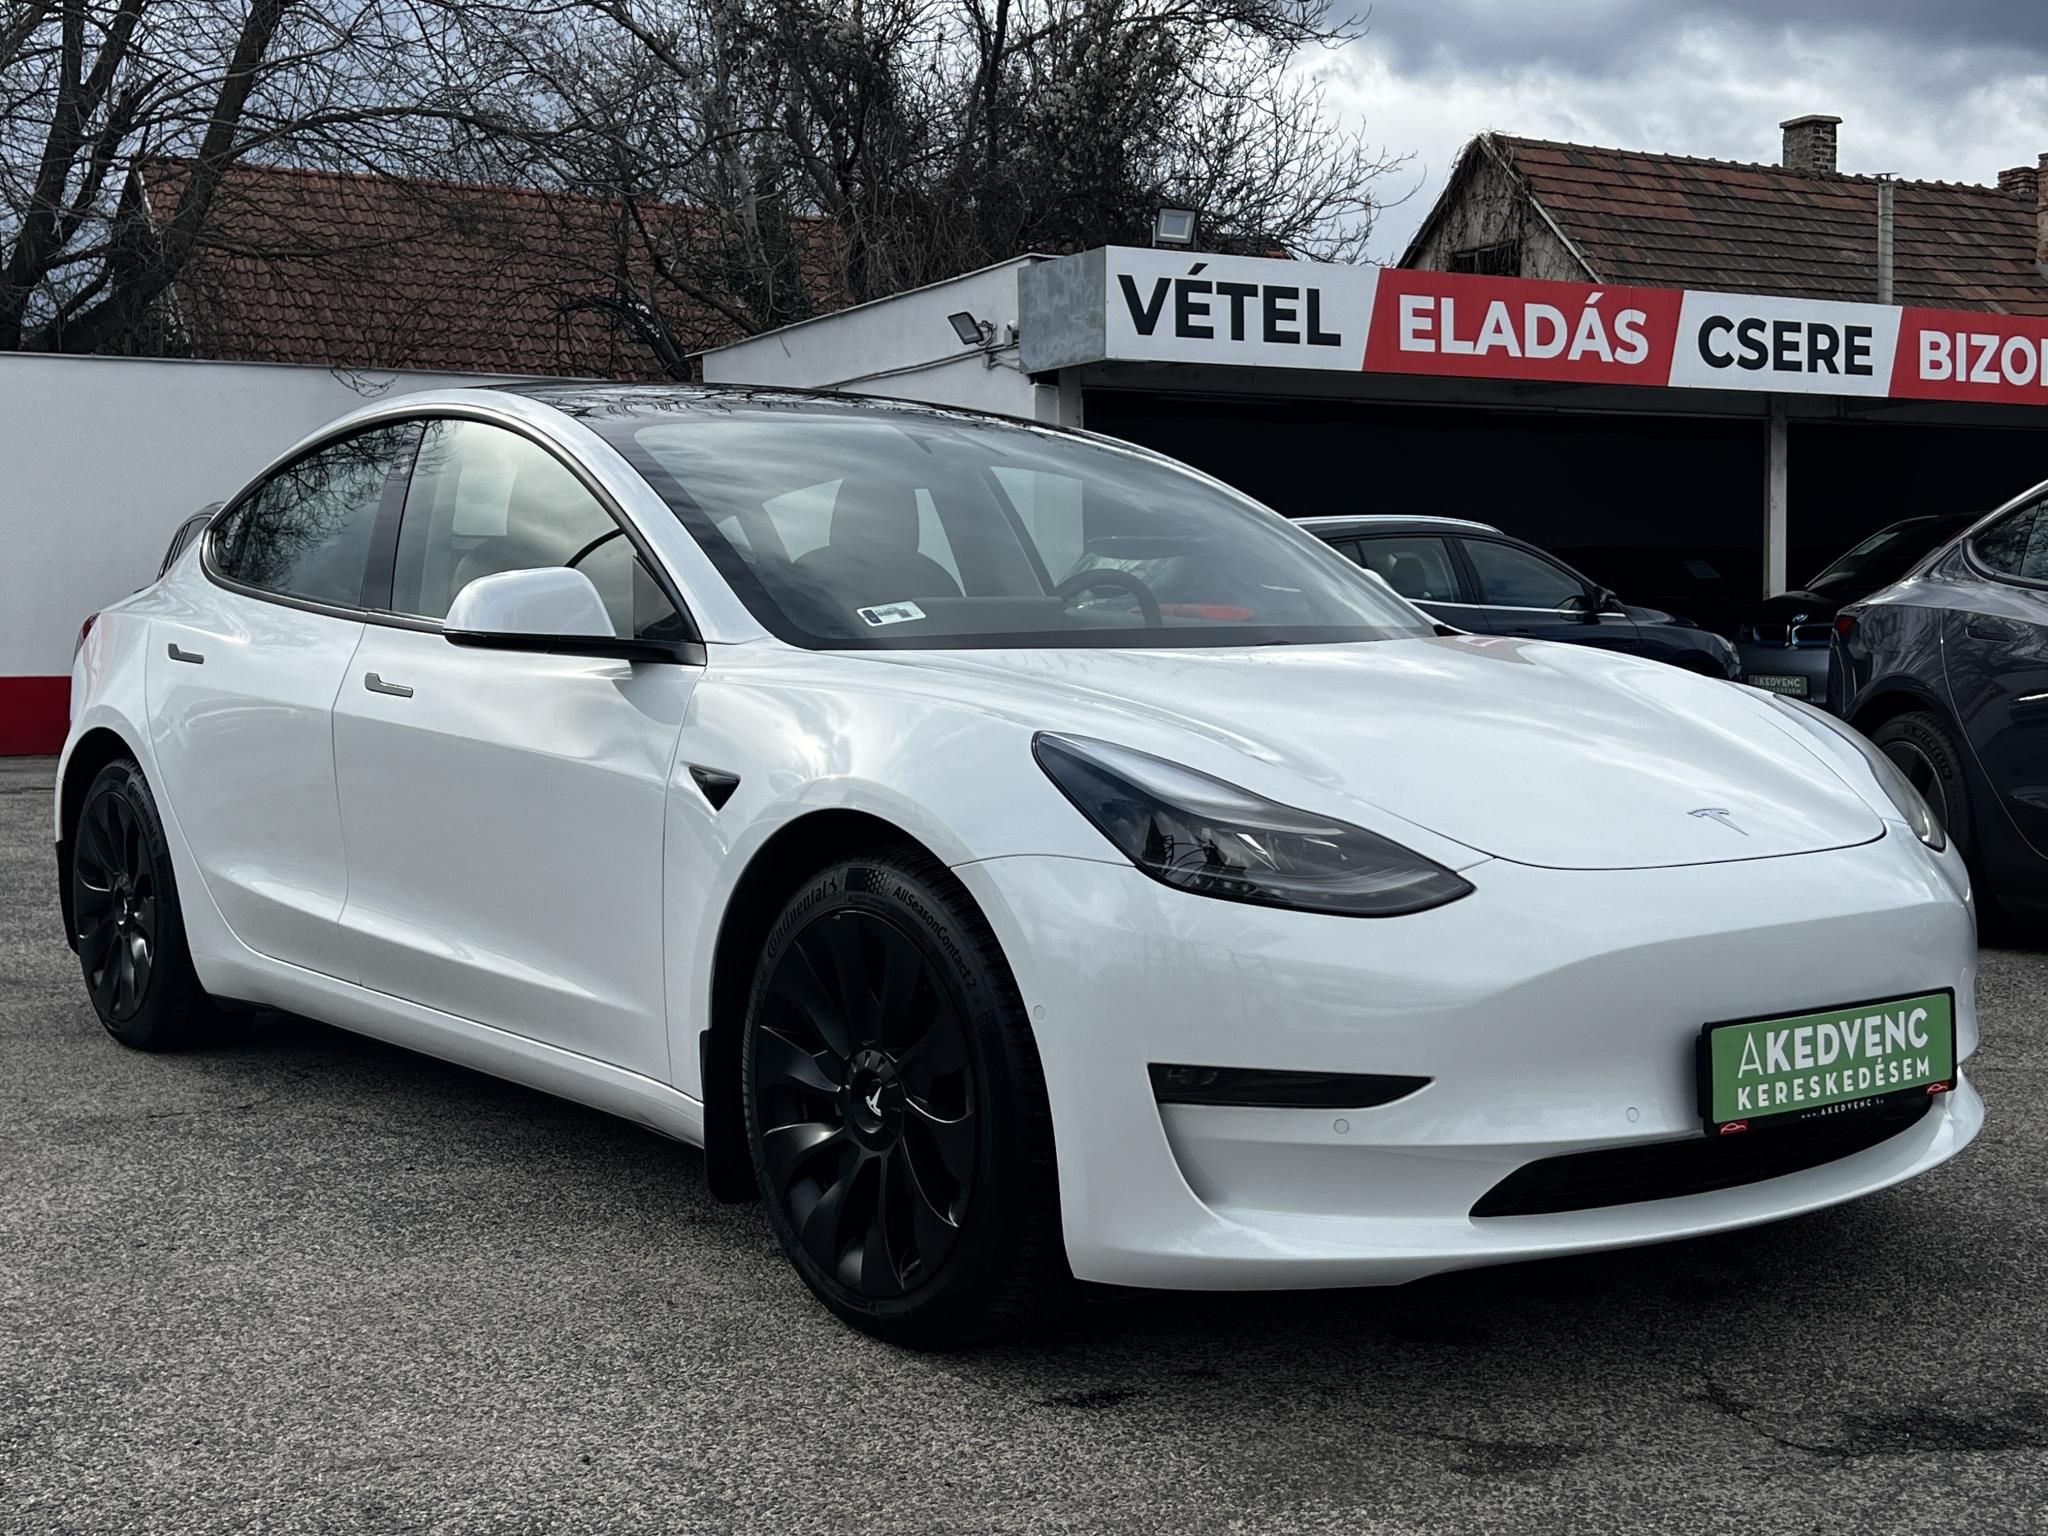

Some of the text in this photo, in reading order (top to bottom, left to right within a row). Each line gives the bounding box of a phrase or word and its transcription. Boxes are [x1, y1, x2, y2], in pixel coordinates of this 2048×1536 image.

[1117, 262, 2048, 387] VÉTEL ELADÁS CSERE BIZO
[767, 878, 828, 960] Continental
[891, 885, 978, 991] AllSeasonContact 2
[1737, 1007, 1929, 1078] AKEDVENC
[1737, 1055, 1930, 1111] KERESKEDÉSEM
